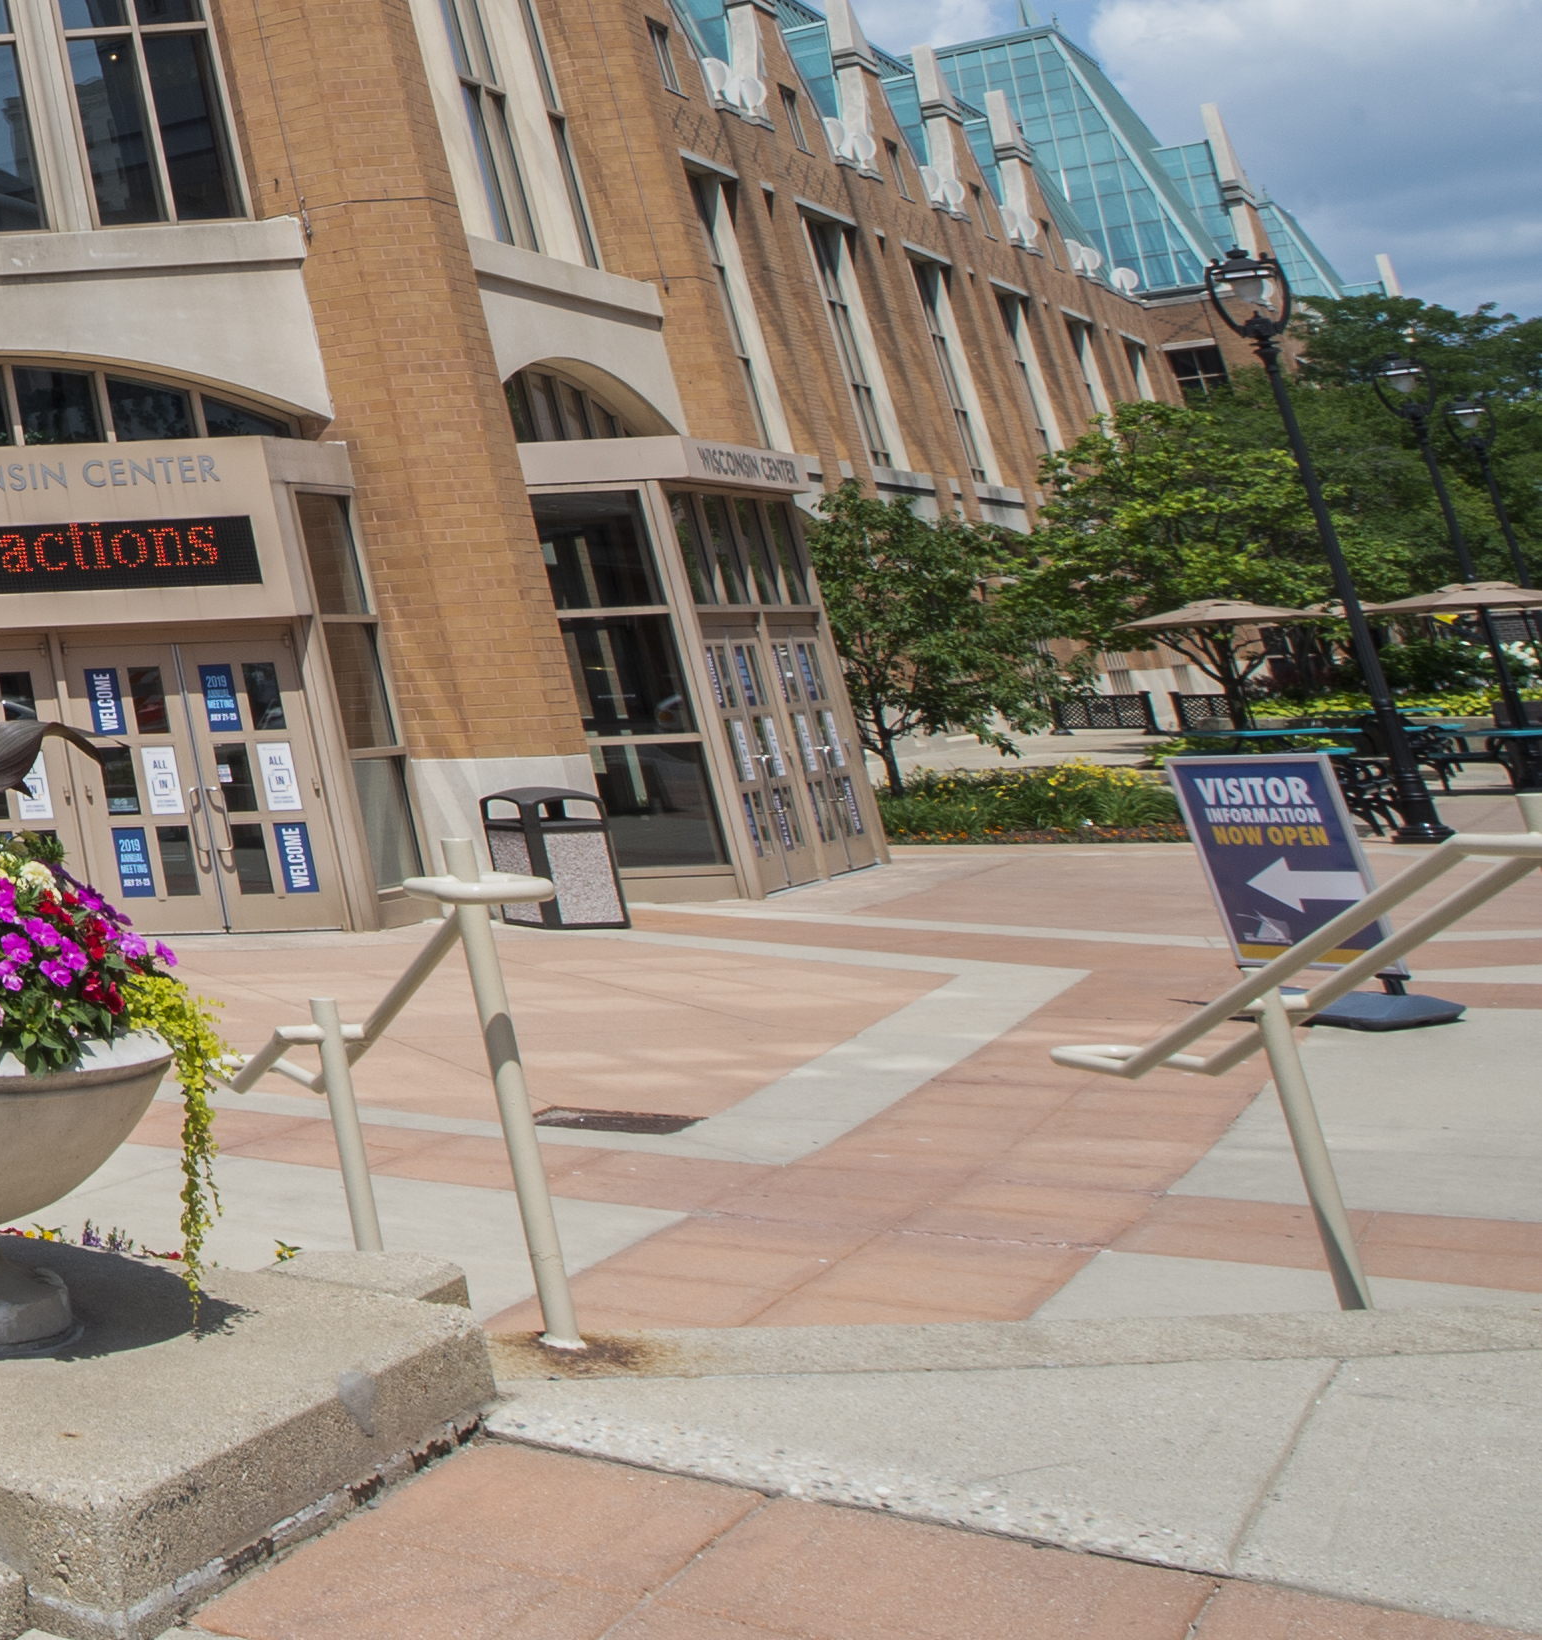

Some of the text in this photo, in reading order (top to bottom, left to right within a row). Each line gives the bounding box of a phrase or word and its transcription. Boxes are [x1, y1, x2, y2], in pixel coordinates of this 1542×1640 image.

[82, 454, 220, 488] CENTER
[696, 446, 799, 484] WISCONSIN CENTER
[205, 675, 227, 688] 2019
[93, 673, 119, 731] WELCOME
[207, 698, 235, 709] MEETING
[153, 760, 168, 769] ALL
[269, 756, 284, 765] ALL
[159, 779, 168, 789] IN
[275, 775, 285, 785] IN
[1193, 776, 1315, 806] VISITOR
[1204, 807, 1322, 824] INFORMATION
[1212, 825, 1331, 847] NOW OPEN
[118, 838, 141, 852] 2019
[120, 853, 144, 862] ANNUAL
[281, 827, 312, 889] WELCOME
[120, 863, 148, 874] MEETING
